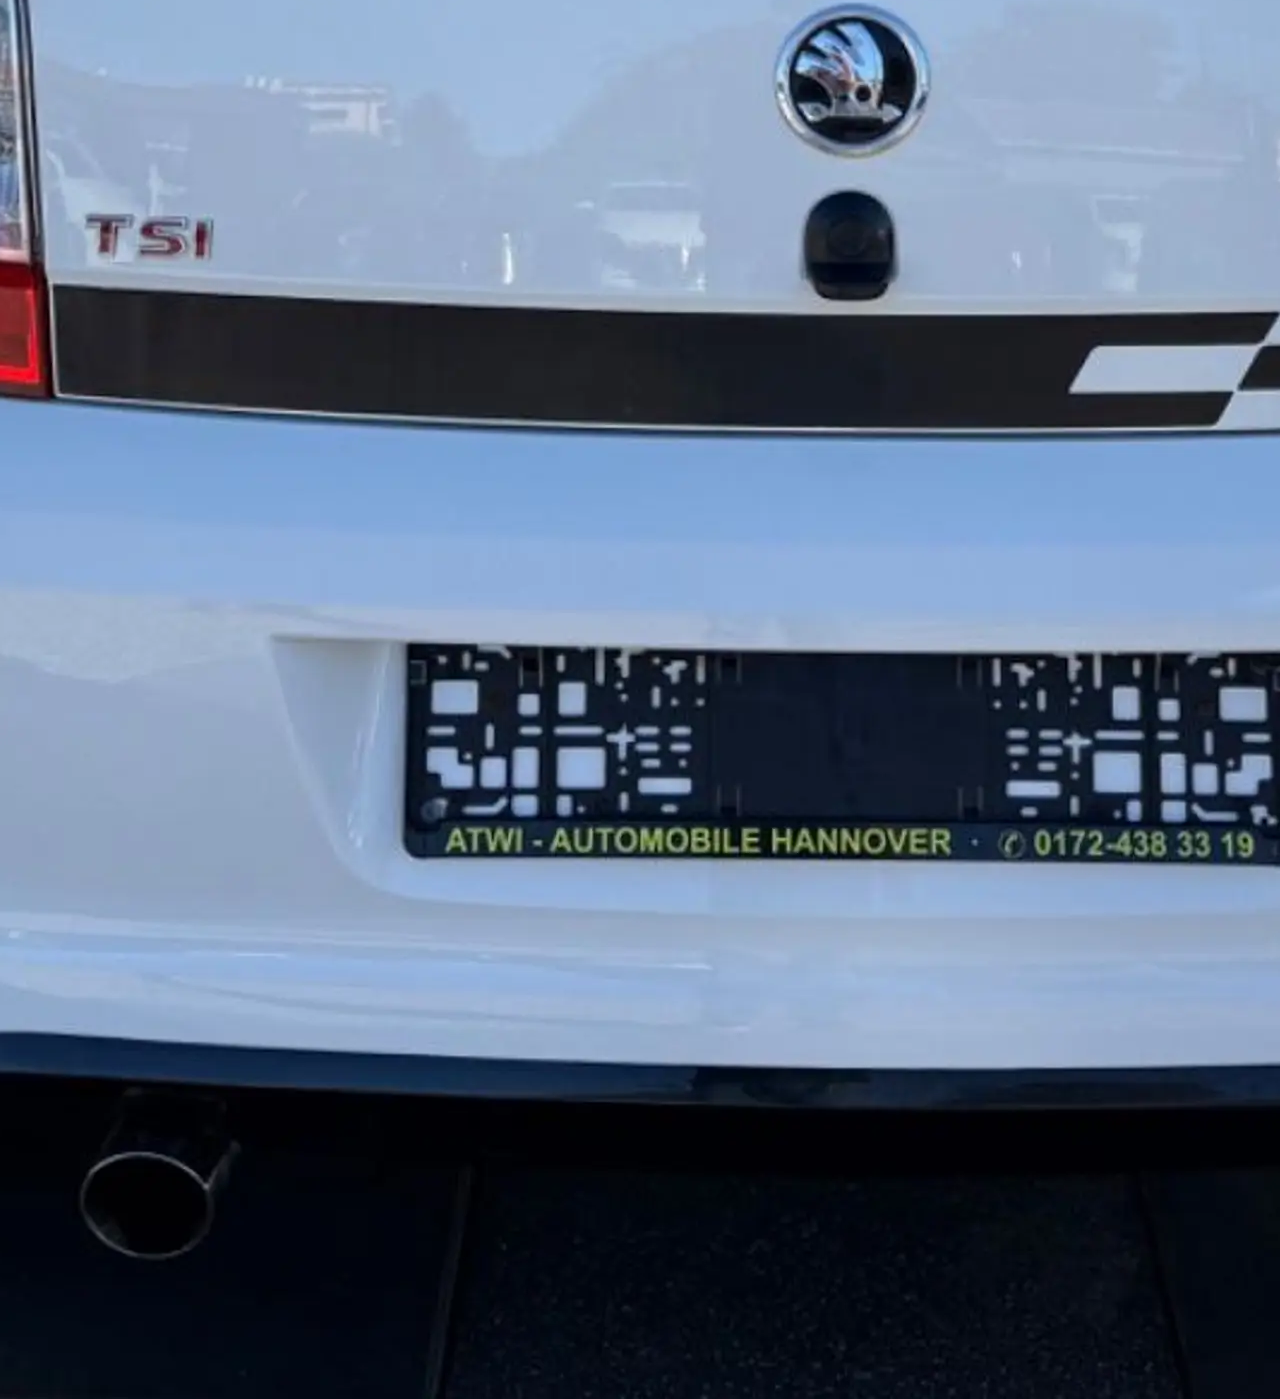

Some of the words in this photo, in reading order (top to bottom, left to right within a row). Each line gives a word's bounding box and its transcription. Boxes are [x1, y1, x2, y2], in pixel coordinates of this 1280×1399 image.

[85, 213, 214, 260] TSI
[445, 827, 523, 853] ATWI
[549, 827, 760, 854] AUTOMOBILE
[771, 827, 951, 855] HANNOVER
[1033, 829, 1167, 857] 0172-438
[1176, 830, 1211, 858] 33
[1222, 831, 1255, 859] 19
